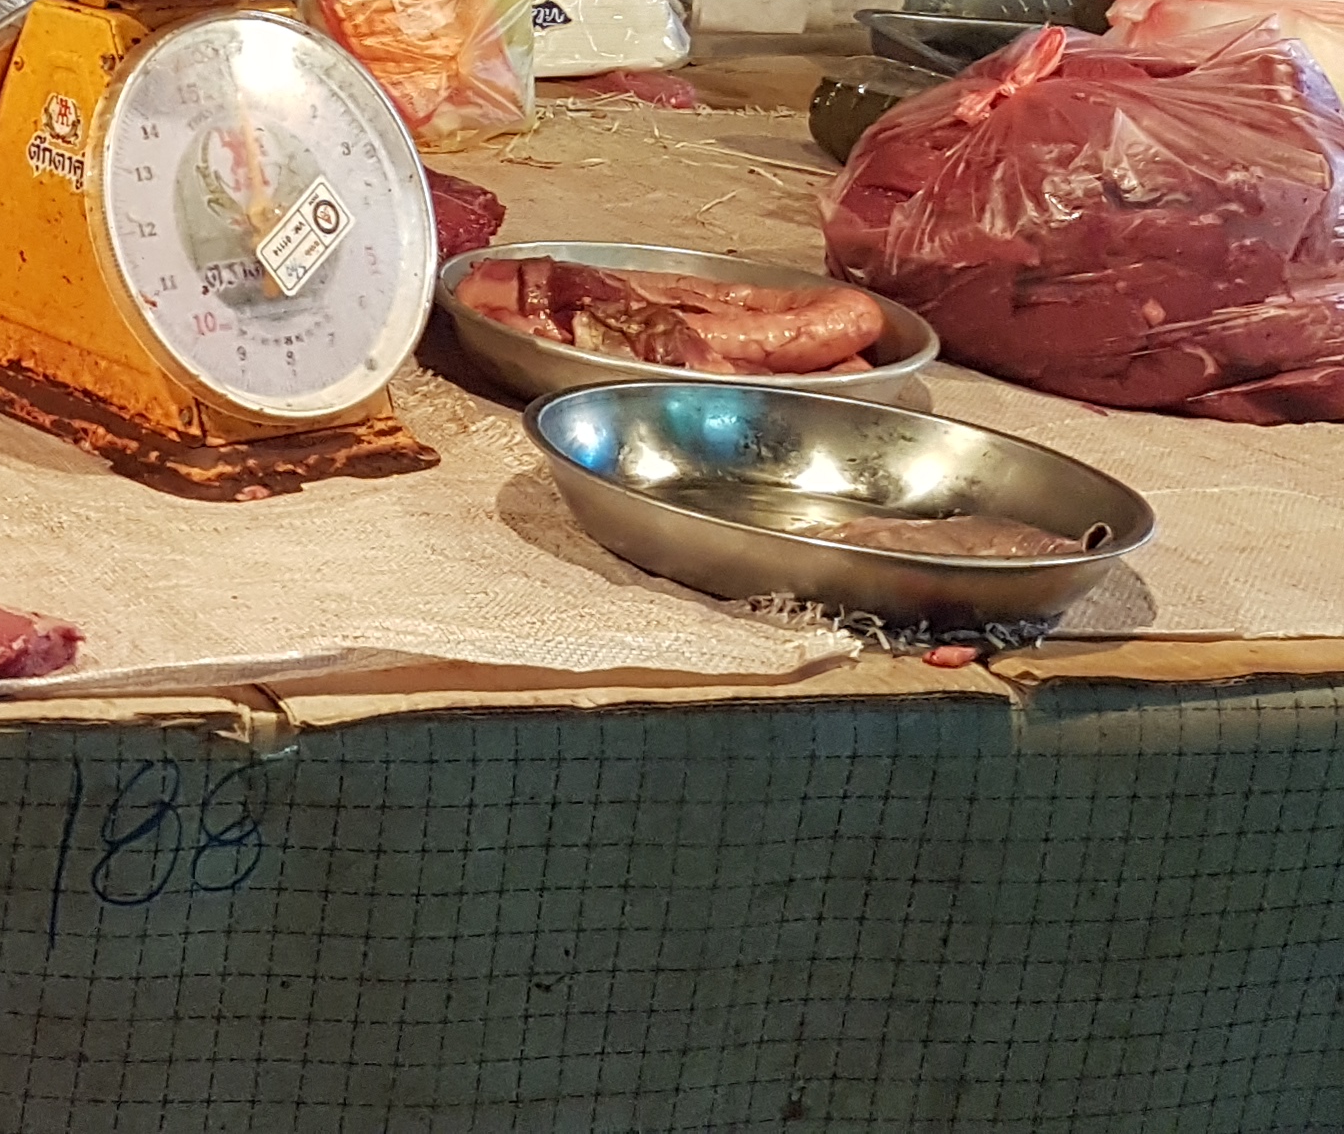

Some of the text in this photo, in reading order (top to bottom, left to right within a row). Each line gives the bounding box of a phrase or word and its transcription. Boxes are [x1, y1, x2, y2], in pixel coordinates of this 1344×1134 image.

[140, 124, 160, 141] 14
[134, 165, 154, 182] 13
[136, 222, 158, 239] 12
[161, 274, 178, 292] 11
[192, 311, 219, 336] 10
[45, 749, 270, 964] 188
